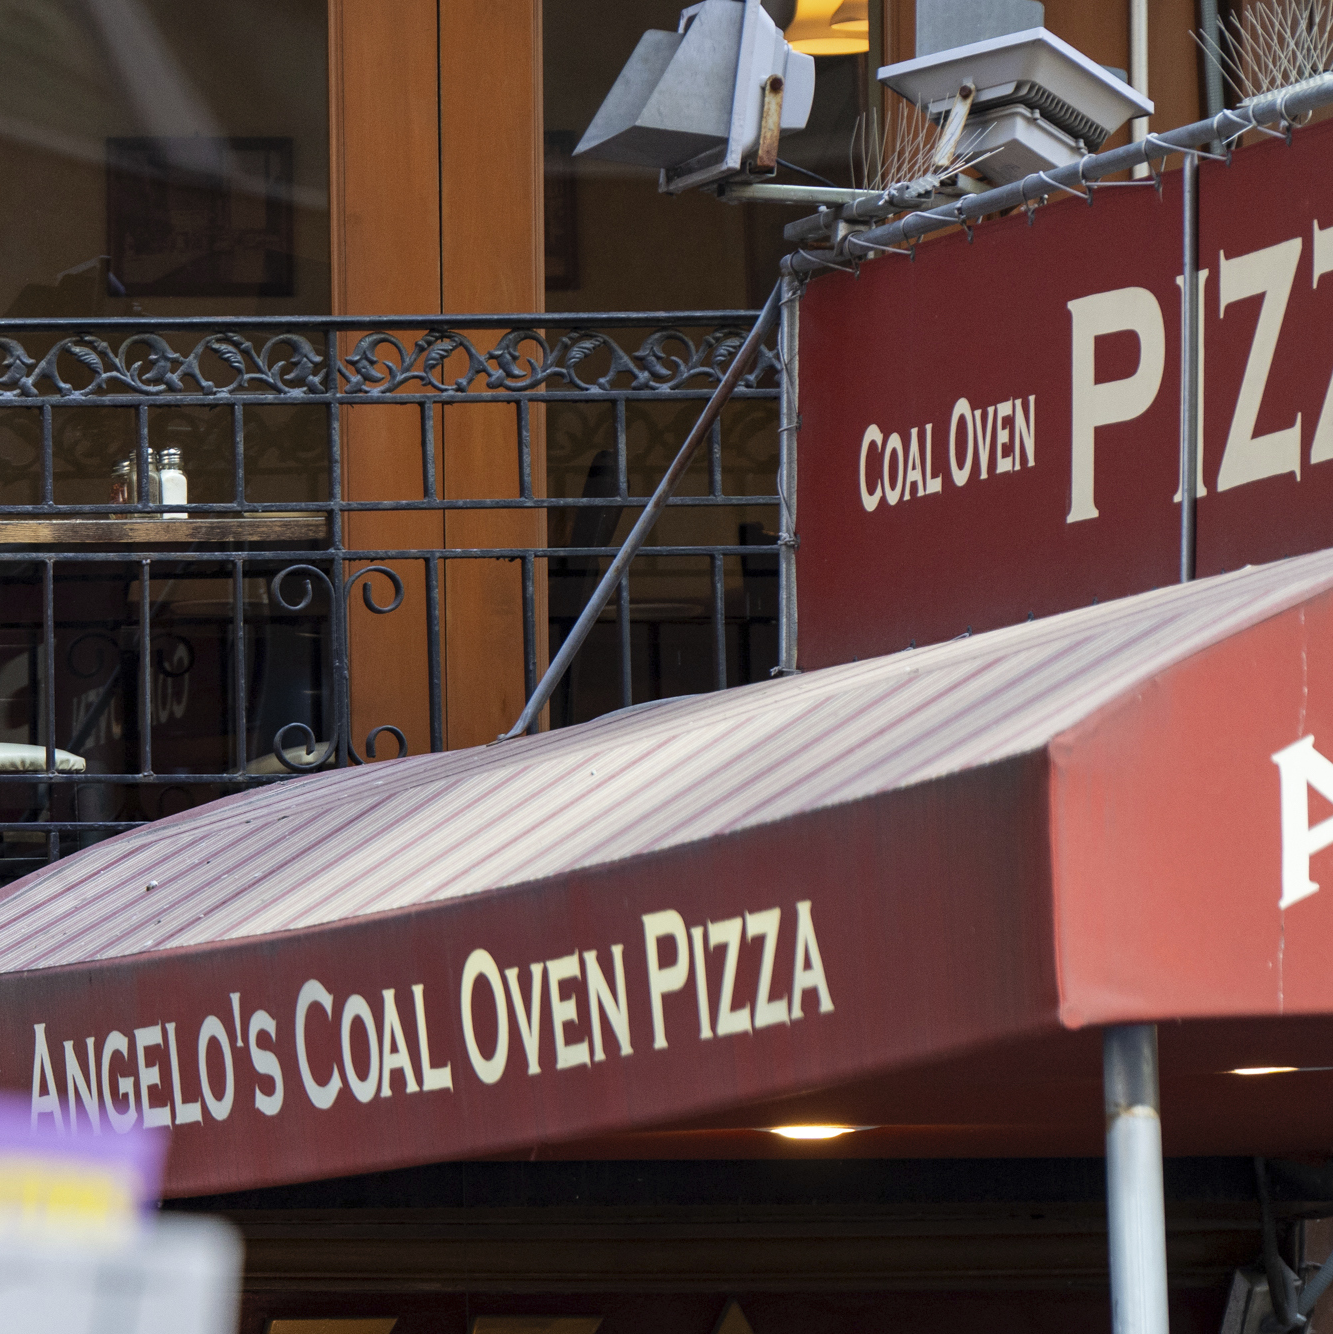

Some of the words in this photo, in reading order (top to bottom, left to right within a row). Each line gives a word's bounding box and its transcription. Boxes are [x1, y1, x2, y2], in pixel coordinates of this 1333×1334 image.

[859, 423, 942, 512] COAL
[949, 395, 1037, 487] OVEN
[1066, 218, 1333, 523] PIZ
[31, 992, 284, 1136] ANGELO'S
[295, 979, 454, 1110] COAL
[460, 945, 634, 1085] OVEN
[642, 900, 835, 1050] PIZZA
